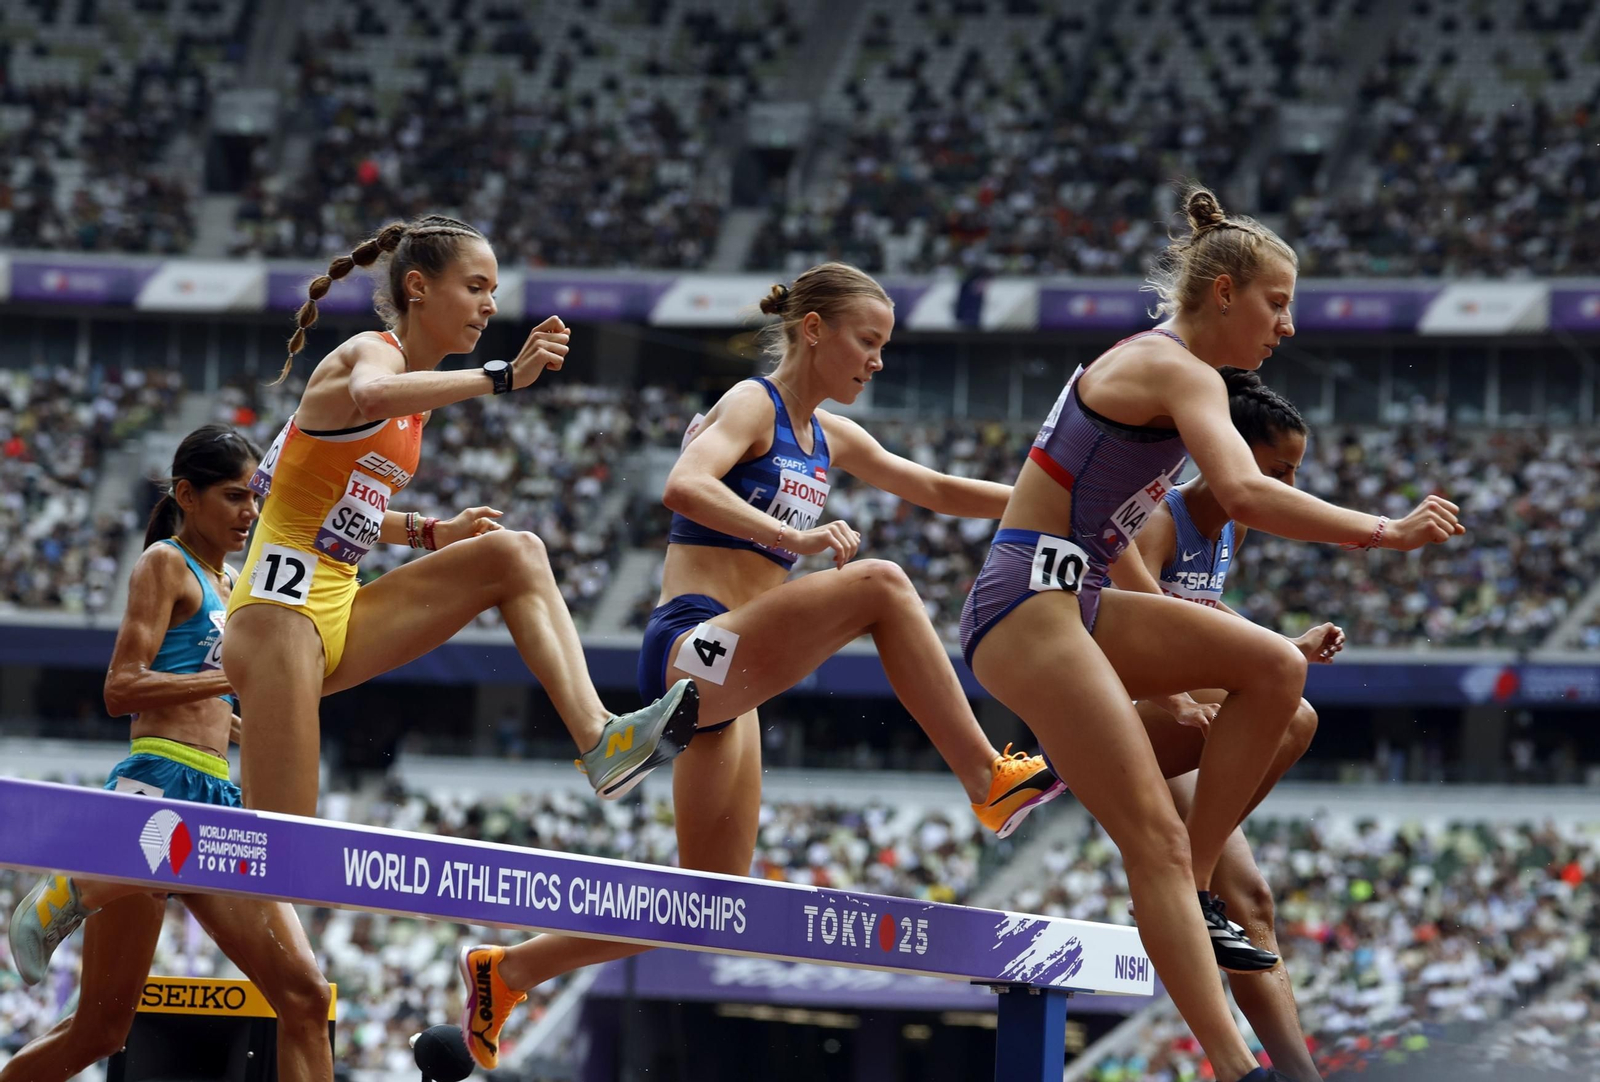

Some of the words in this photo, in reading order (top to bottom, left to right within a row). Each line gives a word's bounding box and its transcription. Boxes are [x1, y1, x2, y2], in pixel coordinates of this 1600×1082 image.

[772, 457, 803, 471] CRAFT
[263, 554, 306, 599] 12
[1039, 547, 1084, 592] 10
[693, 637, 727, 667] 4
[199, 825, 227, 840] WORLD
[227, 829, 268, 845] ATHLETICS
[198, 839, 267, 861] CHAMPIONSHIPS
[343, 847, 430, 895] WORLD
[436, 860, 562, 912] ATHLETICS
[568, 876, 747, 934] CHAMPIONSHIPS
[1114, 954, 1149, 982] NISHI
[141, 983, 246, 1010] SEIKO
